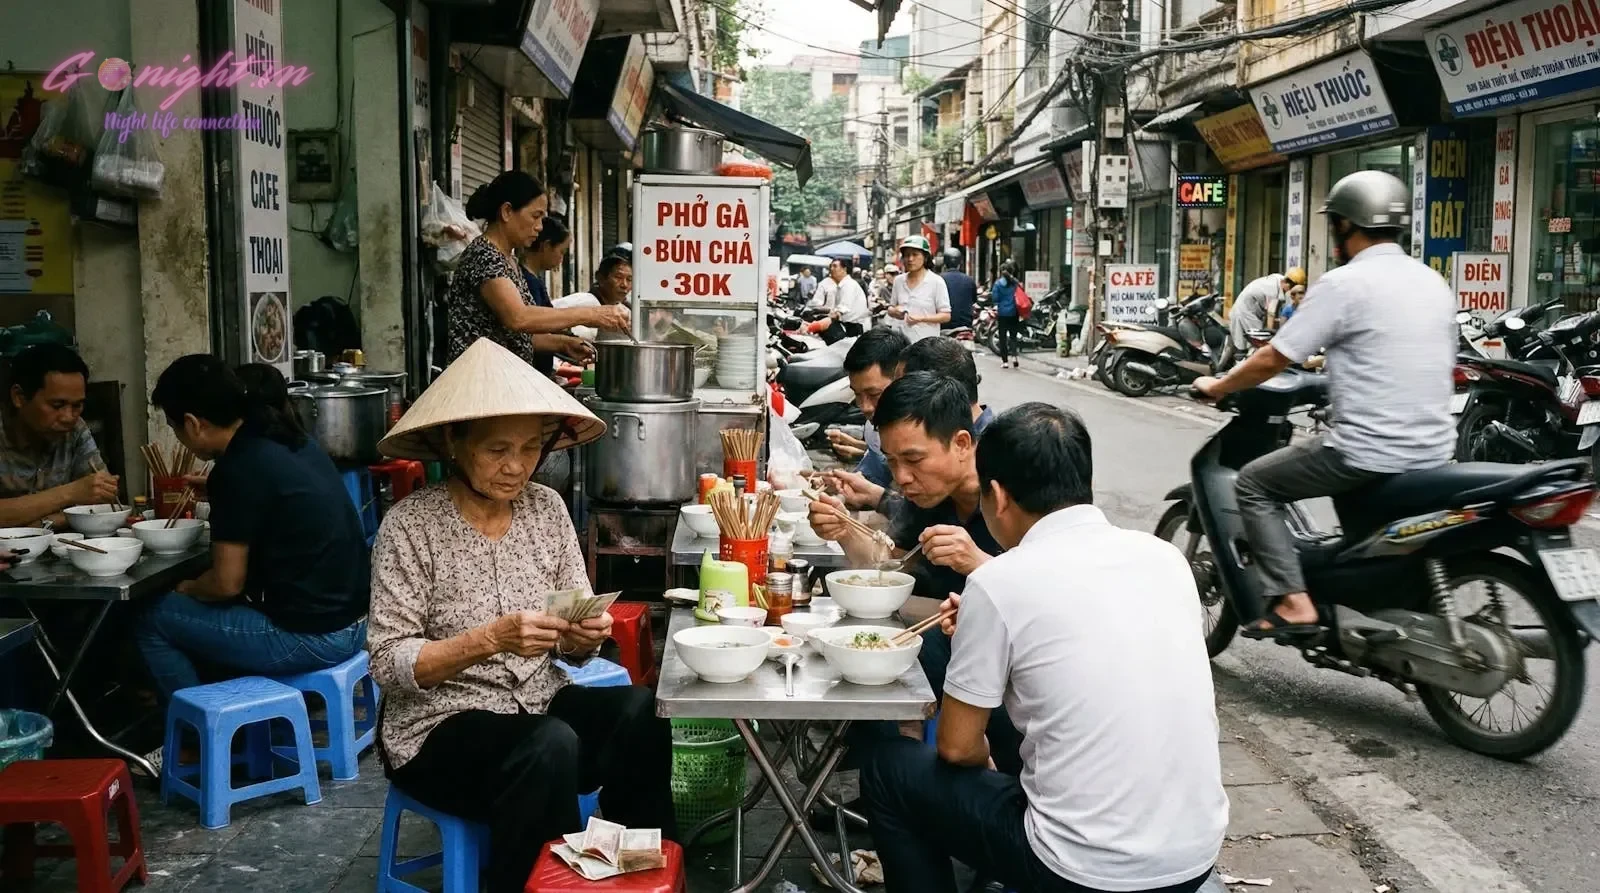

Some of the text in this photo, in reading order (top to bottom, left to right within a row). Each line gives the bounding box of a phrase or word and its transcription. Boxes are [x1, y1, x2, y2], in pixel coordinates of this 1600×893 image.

[1464, 19, 1525, 70] ĐIỆN
[1280, 83, 1317, 119] HIỆU
[1313, 60, 1371, 108] THUỐC
[242, 95, 281, 149] THUỐC
[250, 169, 280, 212] CAFE
[1180, 180, 1223, 203] CAFÉ
[657, 193, 749, 228] PHỞ GÀ
[249, 236, 283, 283] THOẠI
[655, 232, 753, 264] BÚN CHẢ
[674, 272, 732, 296] 30K
[1464, 258, 1501, 286] ĐIỆN
[1459, 291, 1505, 314] THOẠI
